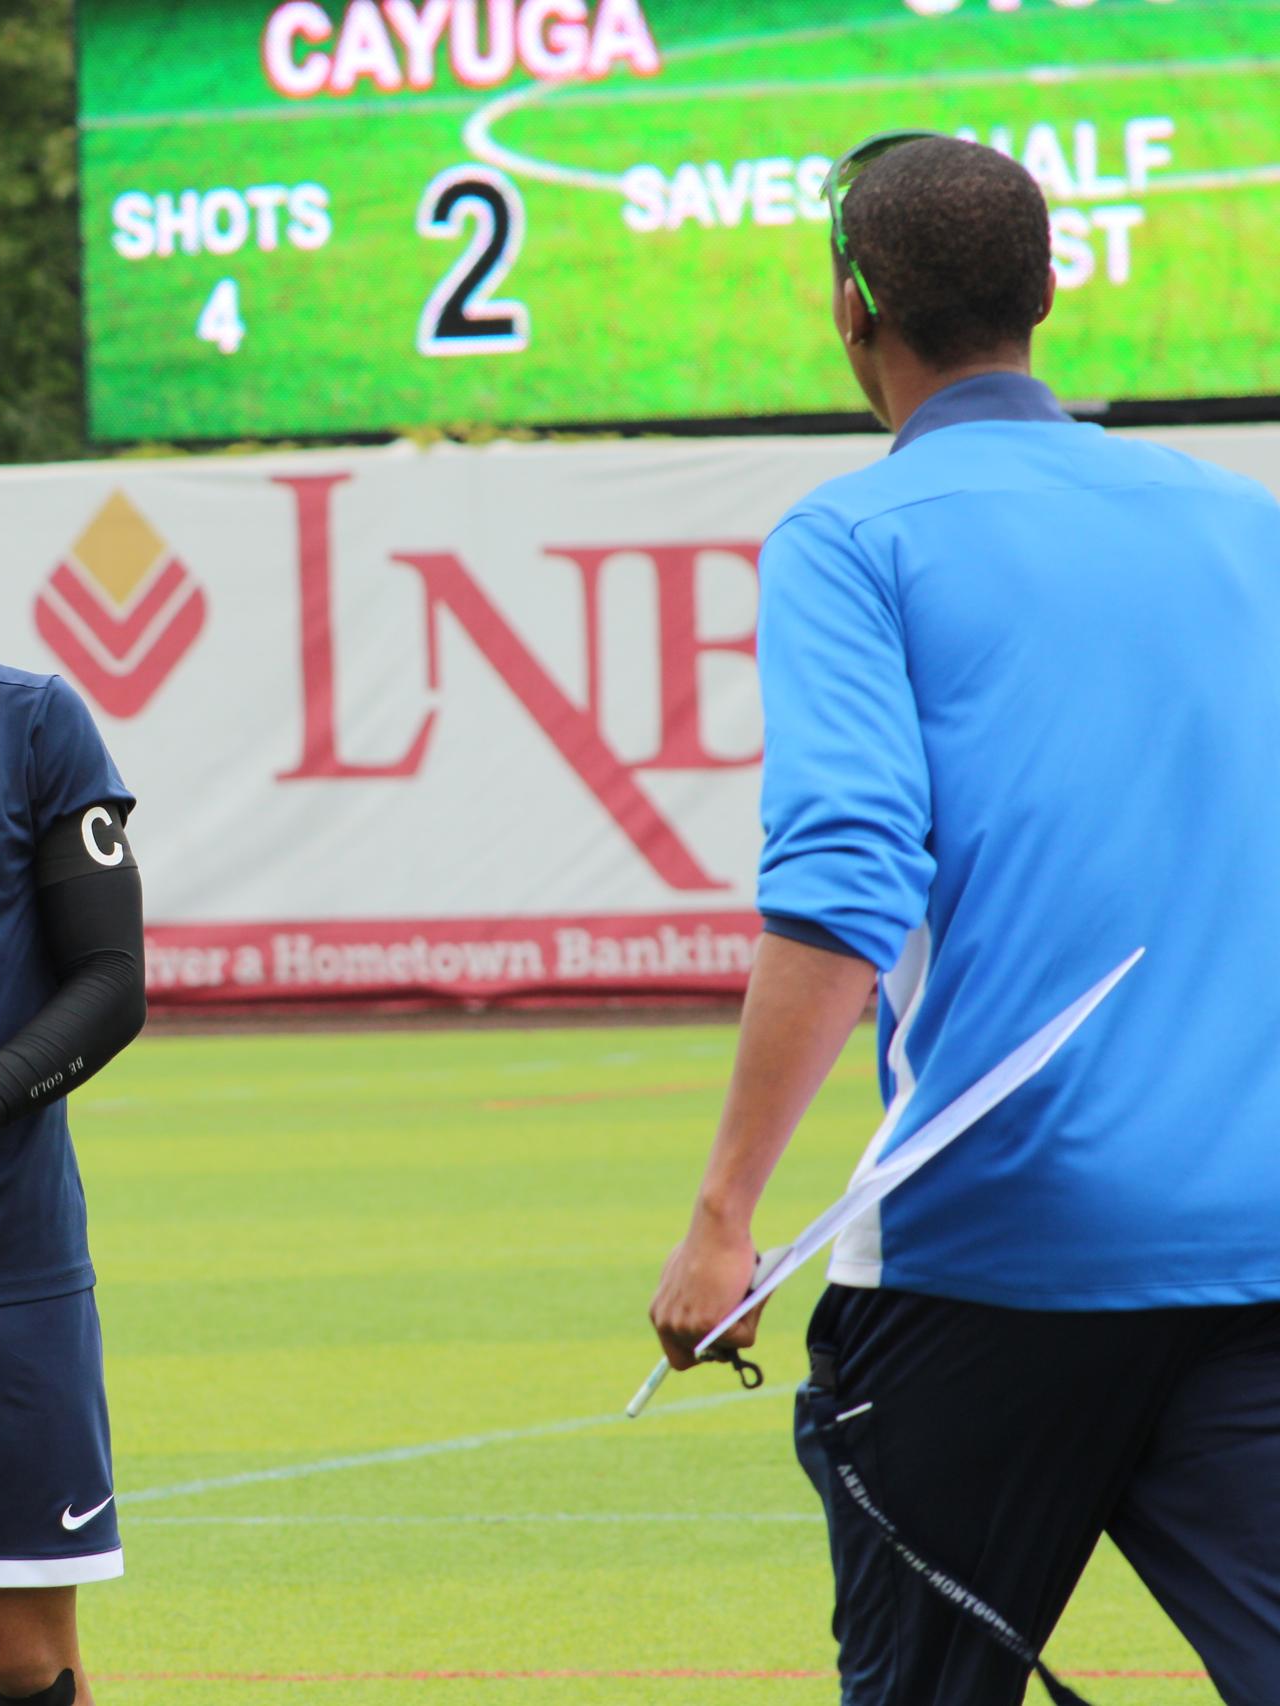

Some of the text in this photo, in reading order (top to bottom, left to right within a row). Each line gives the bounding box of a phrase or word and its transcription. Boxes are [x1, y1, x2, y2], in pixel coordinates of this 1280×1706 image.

[263, 0, 661, 97] CAYUGA
[112, 183, 332, 260] SHOTS
[417, 163, 530, 357] 2
[1048, 205, 1144, 289] ST
[197, 277, 245, 354] 4
[81, 806, 124, 867] C
[232, 945, 266, 986] a
[271, 932, 545, 985] Hometown
[553, 923, 758, 979] Bankin
[30, 1056, 84, 1099] BE GOLD
